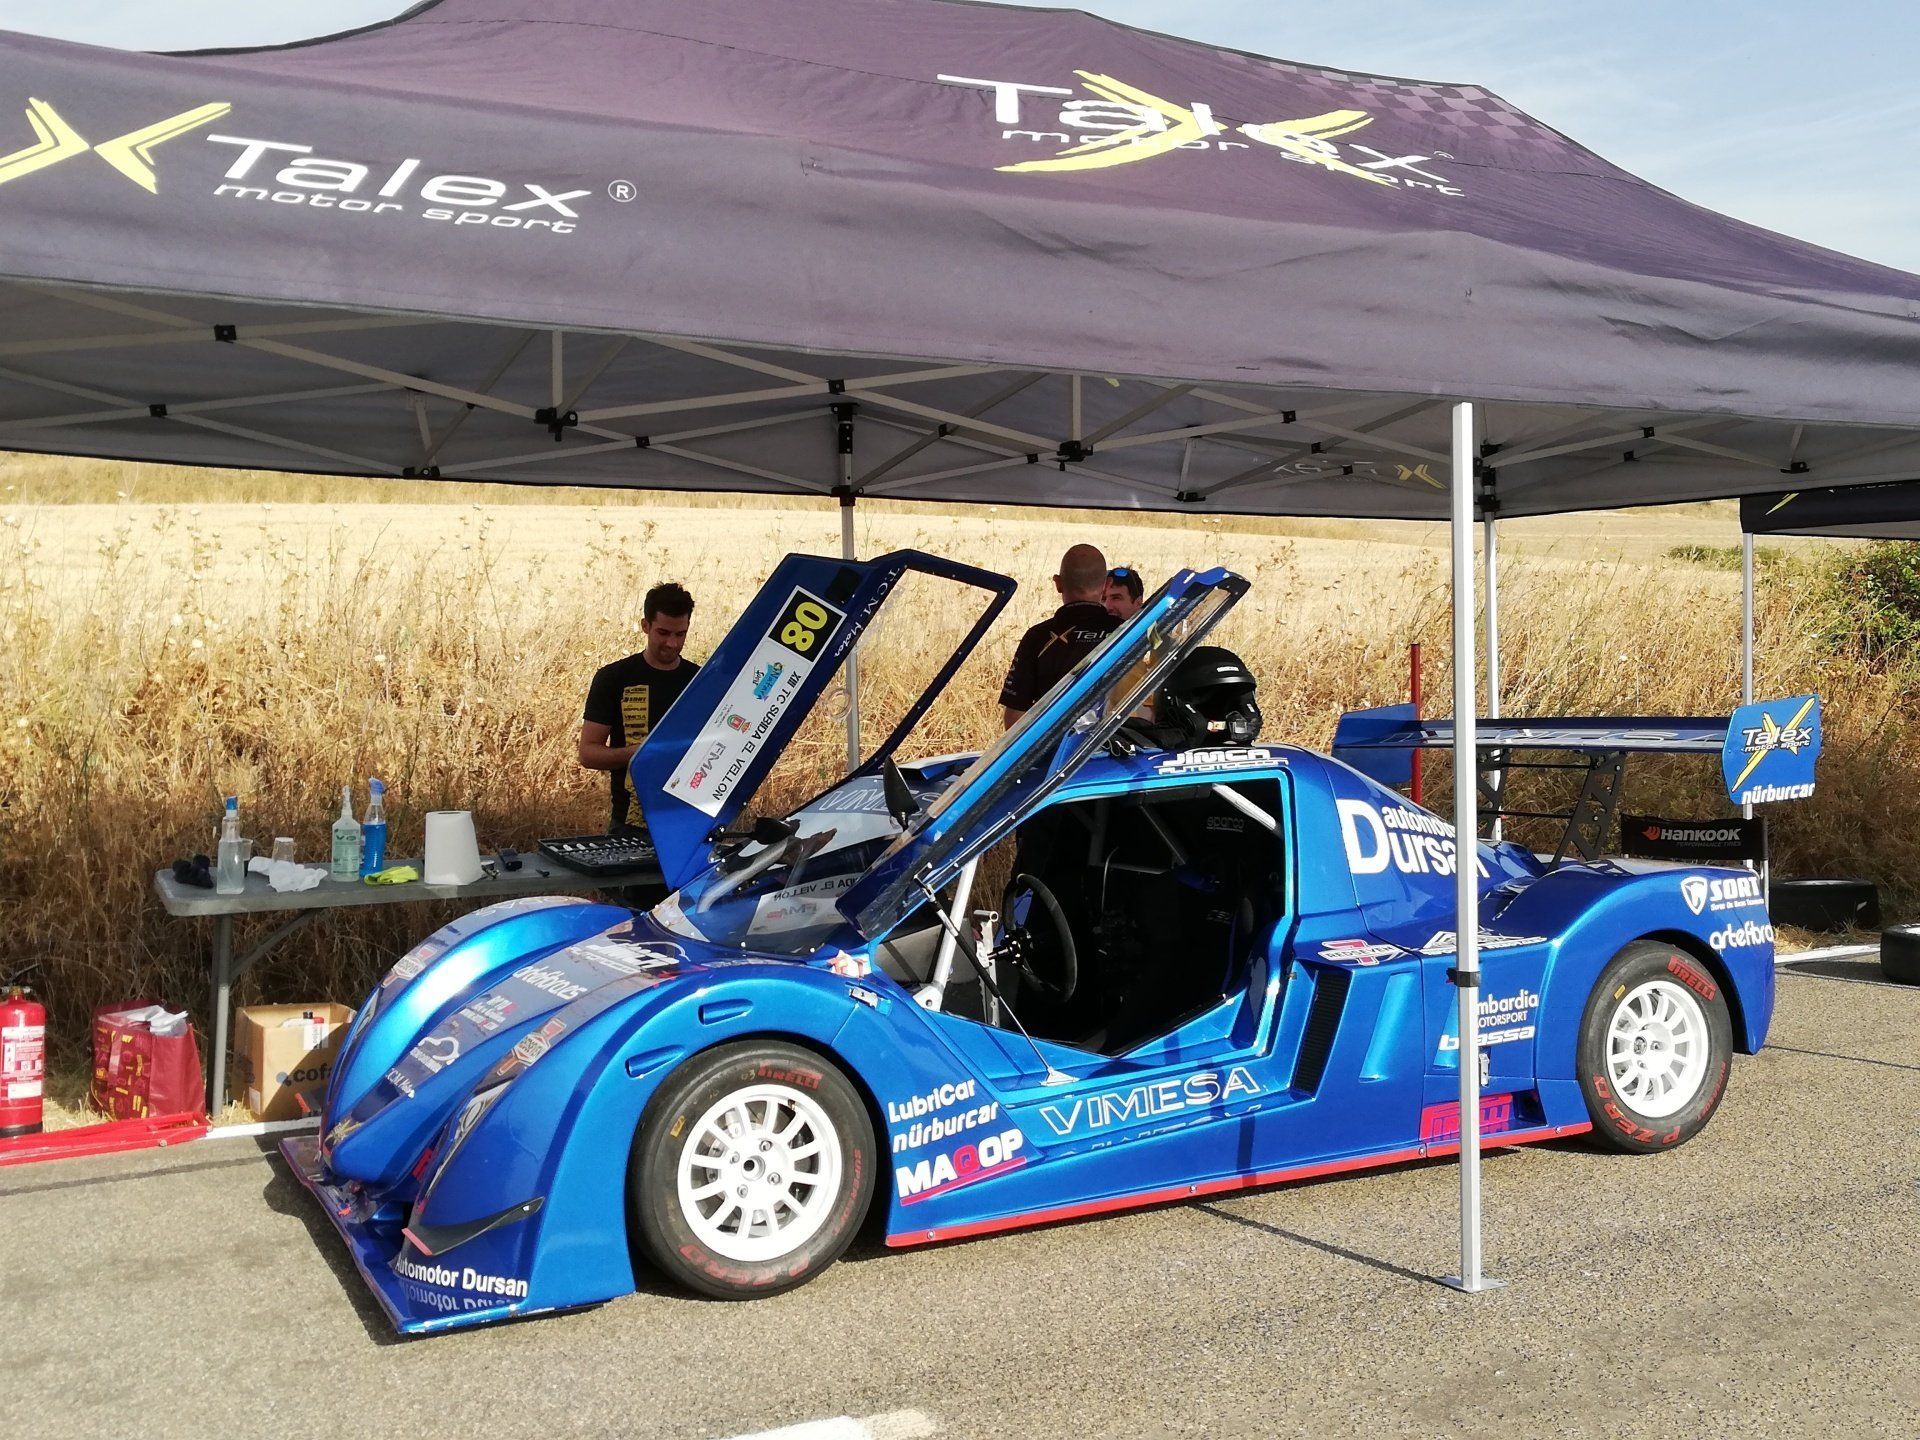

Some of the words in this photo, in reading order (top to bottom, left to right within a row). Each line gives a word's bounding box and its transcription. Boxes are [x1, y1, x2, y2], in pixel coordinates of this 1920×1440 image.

[937, 73, 1450, 183] Talex
[207, 134, 592, 219] Talex
[213, 184, 404, 215] motor
[422, 207, 578, 234] sport
[776, 687, 791, 705] TC
[752, 704, 780, 741] SUBIDA
[1742, 726, 1814, 746] Talex
[741, 740, 757, 756] EL
[1744, 743, 1778, 752] motor
[1781, 740, 1810, 749] sport
[1741, 783, 1815, 805] nürburcar
[1710, 877, 1760, 901] SORT
[1666, 955, 1717, 1001] PIRELLI
[758, 1061, 824, 1089] PIRELLI
[887, 1078, 976, 1124] LubriCar
[1039, 1066, 1261, 1136] VIMESA
[892, 1101, 999, 1154] nürburcar
[895, 1128, 1025, 1199] MAQOP
[461, 1267, 528, 1298] Dursan
